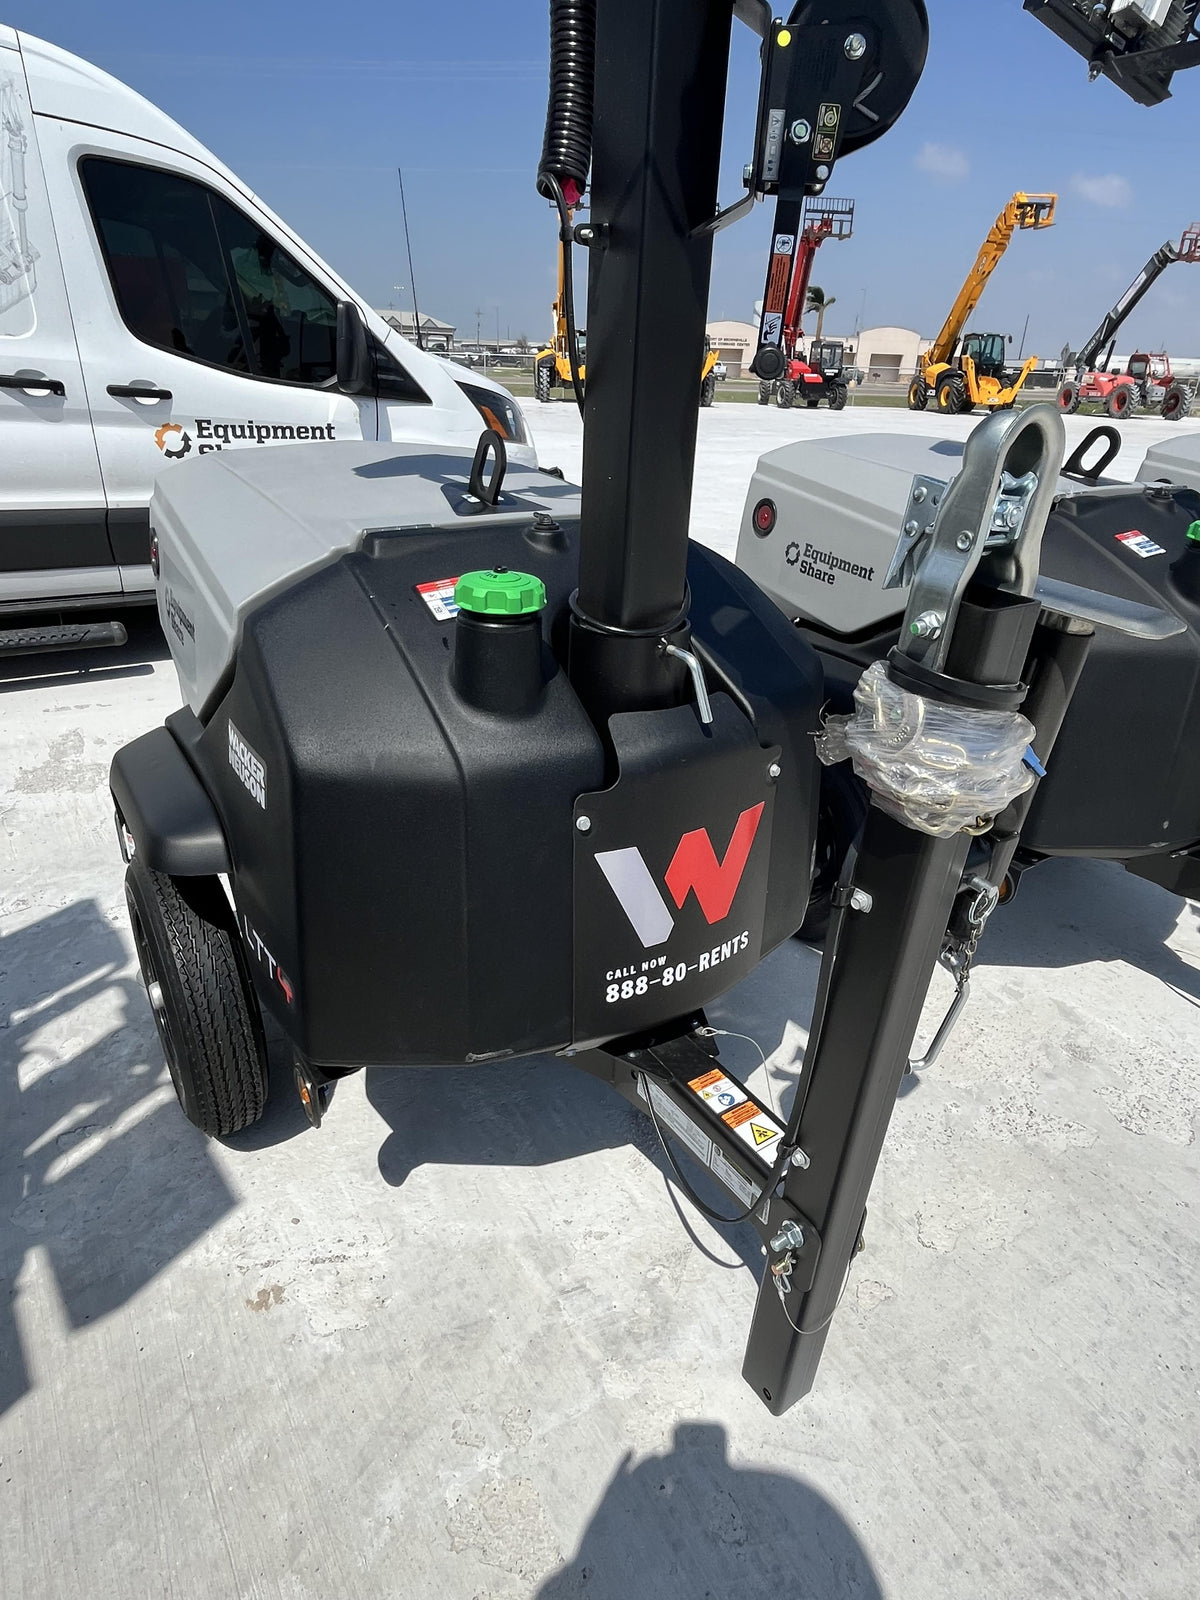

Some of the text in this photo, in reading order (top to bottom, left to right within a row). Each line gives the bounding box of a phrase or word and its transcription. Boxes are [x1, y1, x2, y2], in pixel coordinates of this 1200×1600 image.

[194, 419, 336, 443] Equipment
[800, 560, 835, 585] Share
[803, 543, 875, 581] Equipment
[228, 724, 266, 789] WACKER
[228, 745, 266, 810] NEUSON
[605, 930, 750, 1003] 888-80-RENTS
[606, 955, 668, 981] CALL NOW
